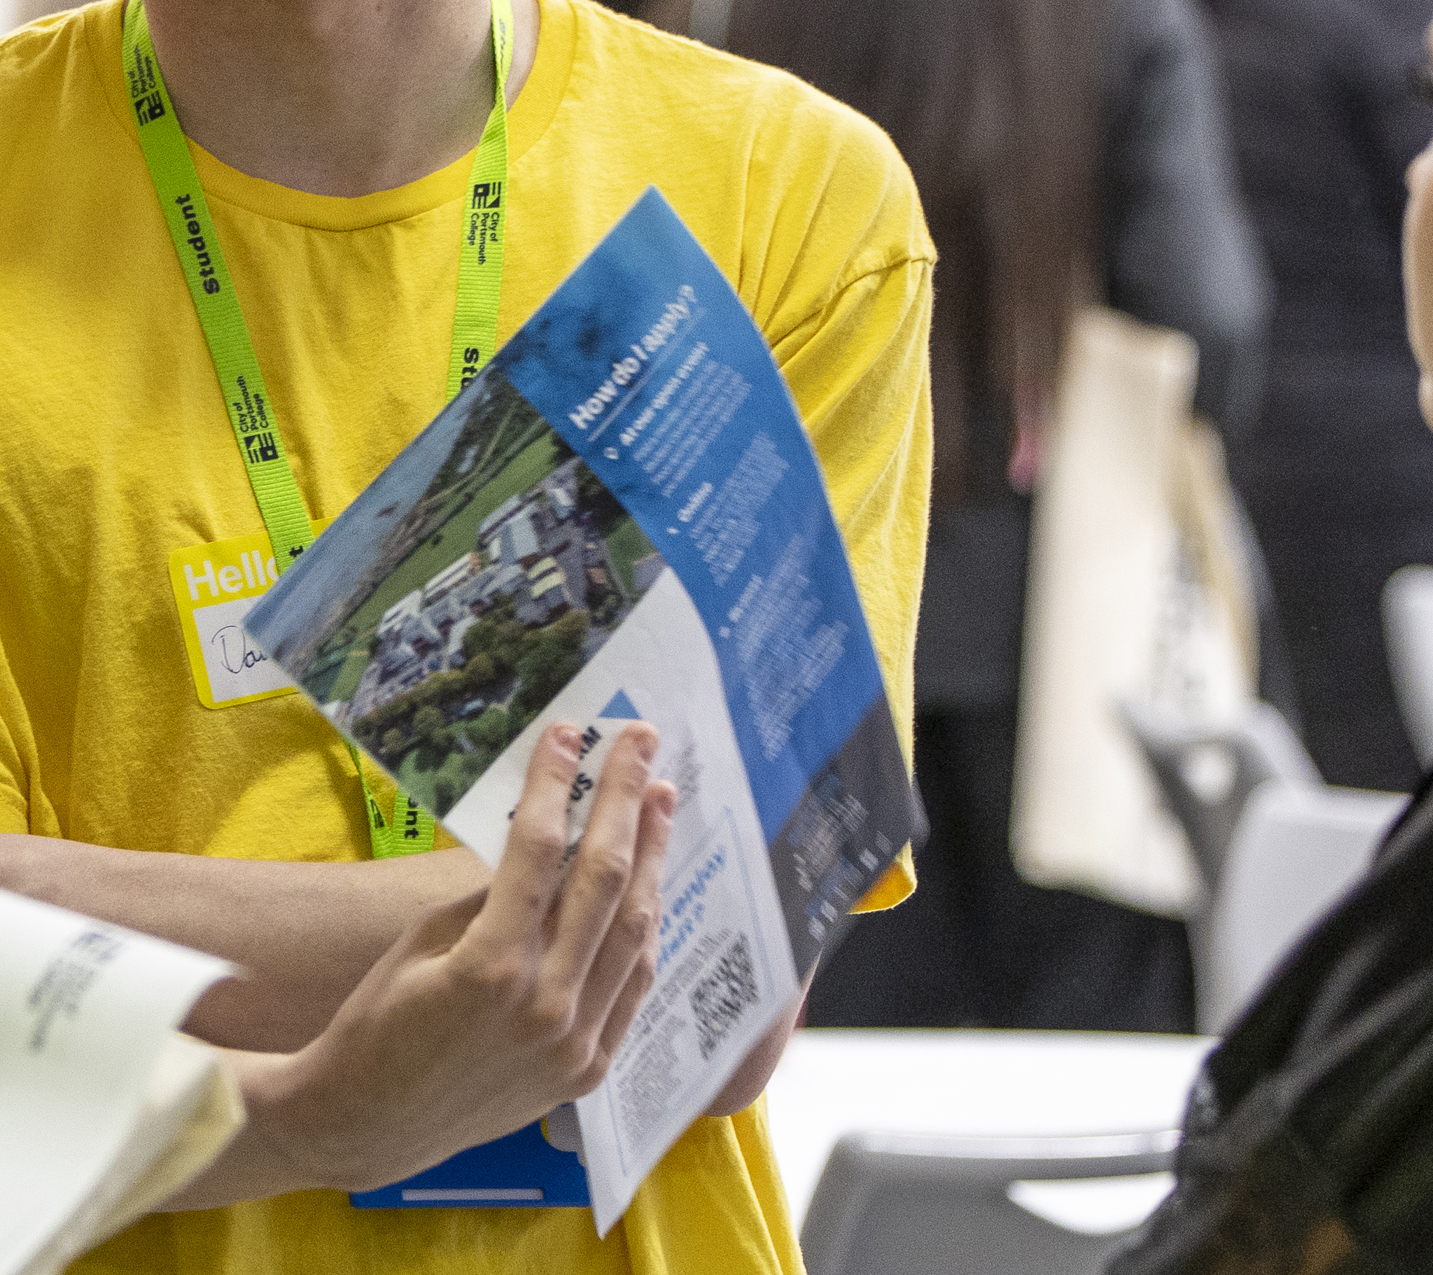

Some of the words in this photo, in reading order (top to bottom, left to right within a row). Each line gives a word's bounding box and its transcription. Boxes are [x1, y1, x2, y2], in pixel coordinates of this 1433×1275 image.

[468, 213, 479, 245] College
[489, 231, 499, 242] of
[490, 212, 499, 230] City
[175, 193, 220, 295] student
[479, 213, 489, 265] Portsmouth
[232, 402, 243, 412] of
[236, 375, 259, 431] Portsmouth
[568, 379, 618, 430] How
[611, 357, 641, 385] do
[238, 413, 249, 433] City
[253, 393, 269, 429] College
